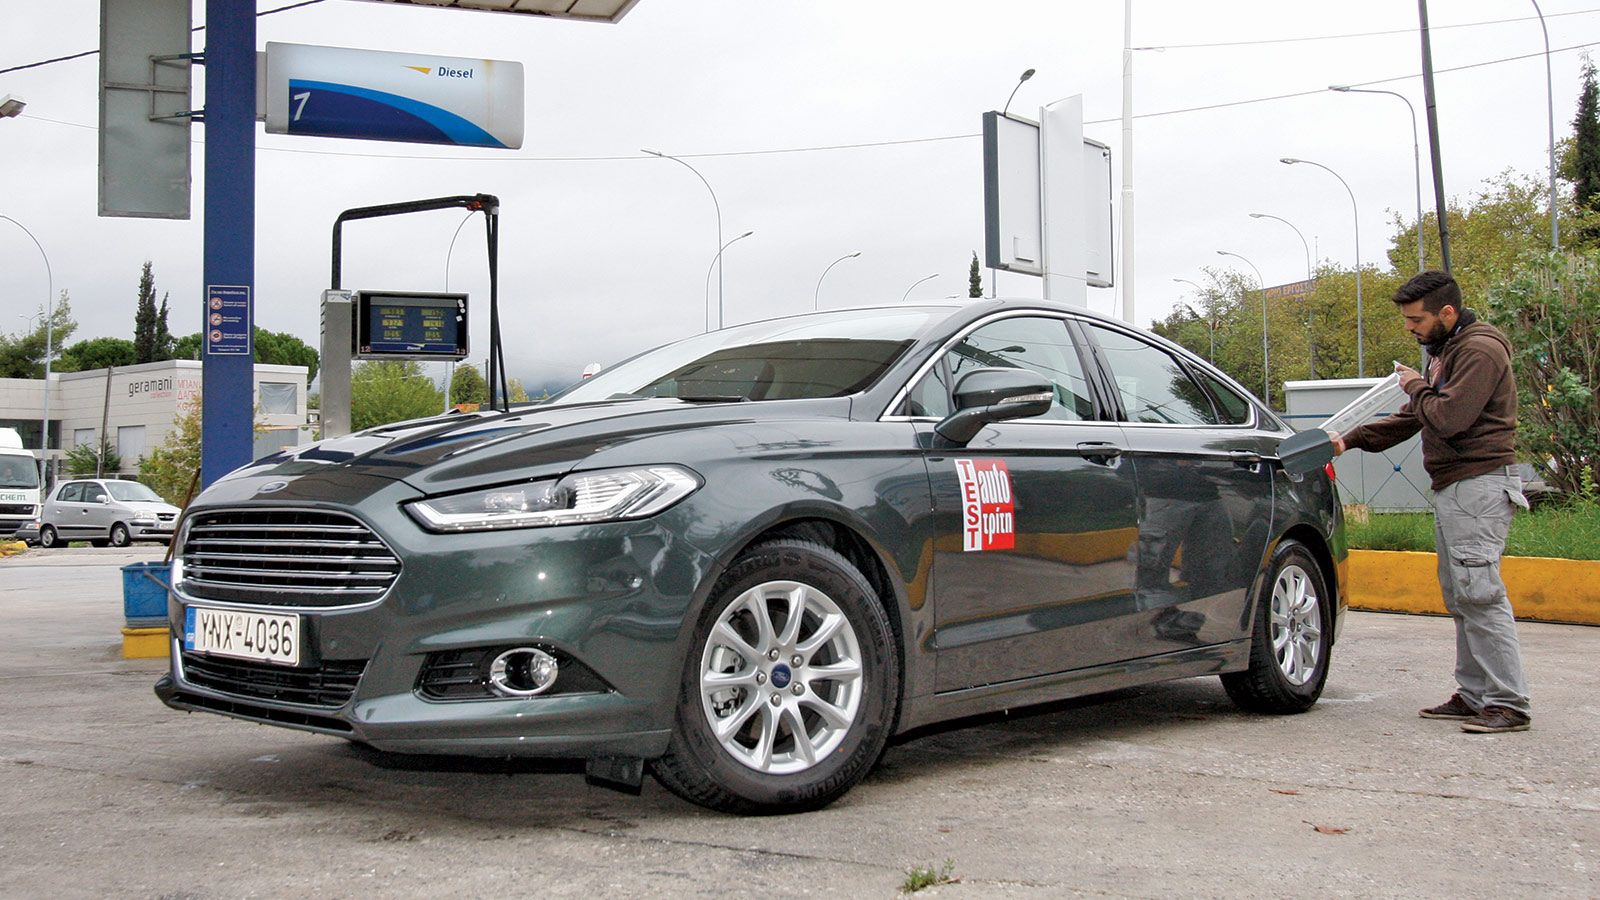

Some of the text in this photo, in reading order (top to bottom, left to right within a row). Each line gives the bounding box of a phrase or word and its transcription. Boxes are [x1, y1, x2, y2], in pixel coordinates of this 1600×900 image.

[438, 67, 473, 79] Diesel
[294, 92, 311, 121] 7
[129, 376, 172, 397] geramani
[977, 463, 1011, 504] auto
[958, 460, 979, 548] TEST
[983, 507, 1013, 545] τρίτη
